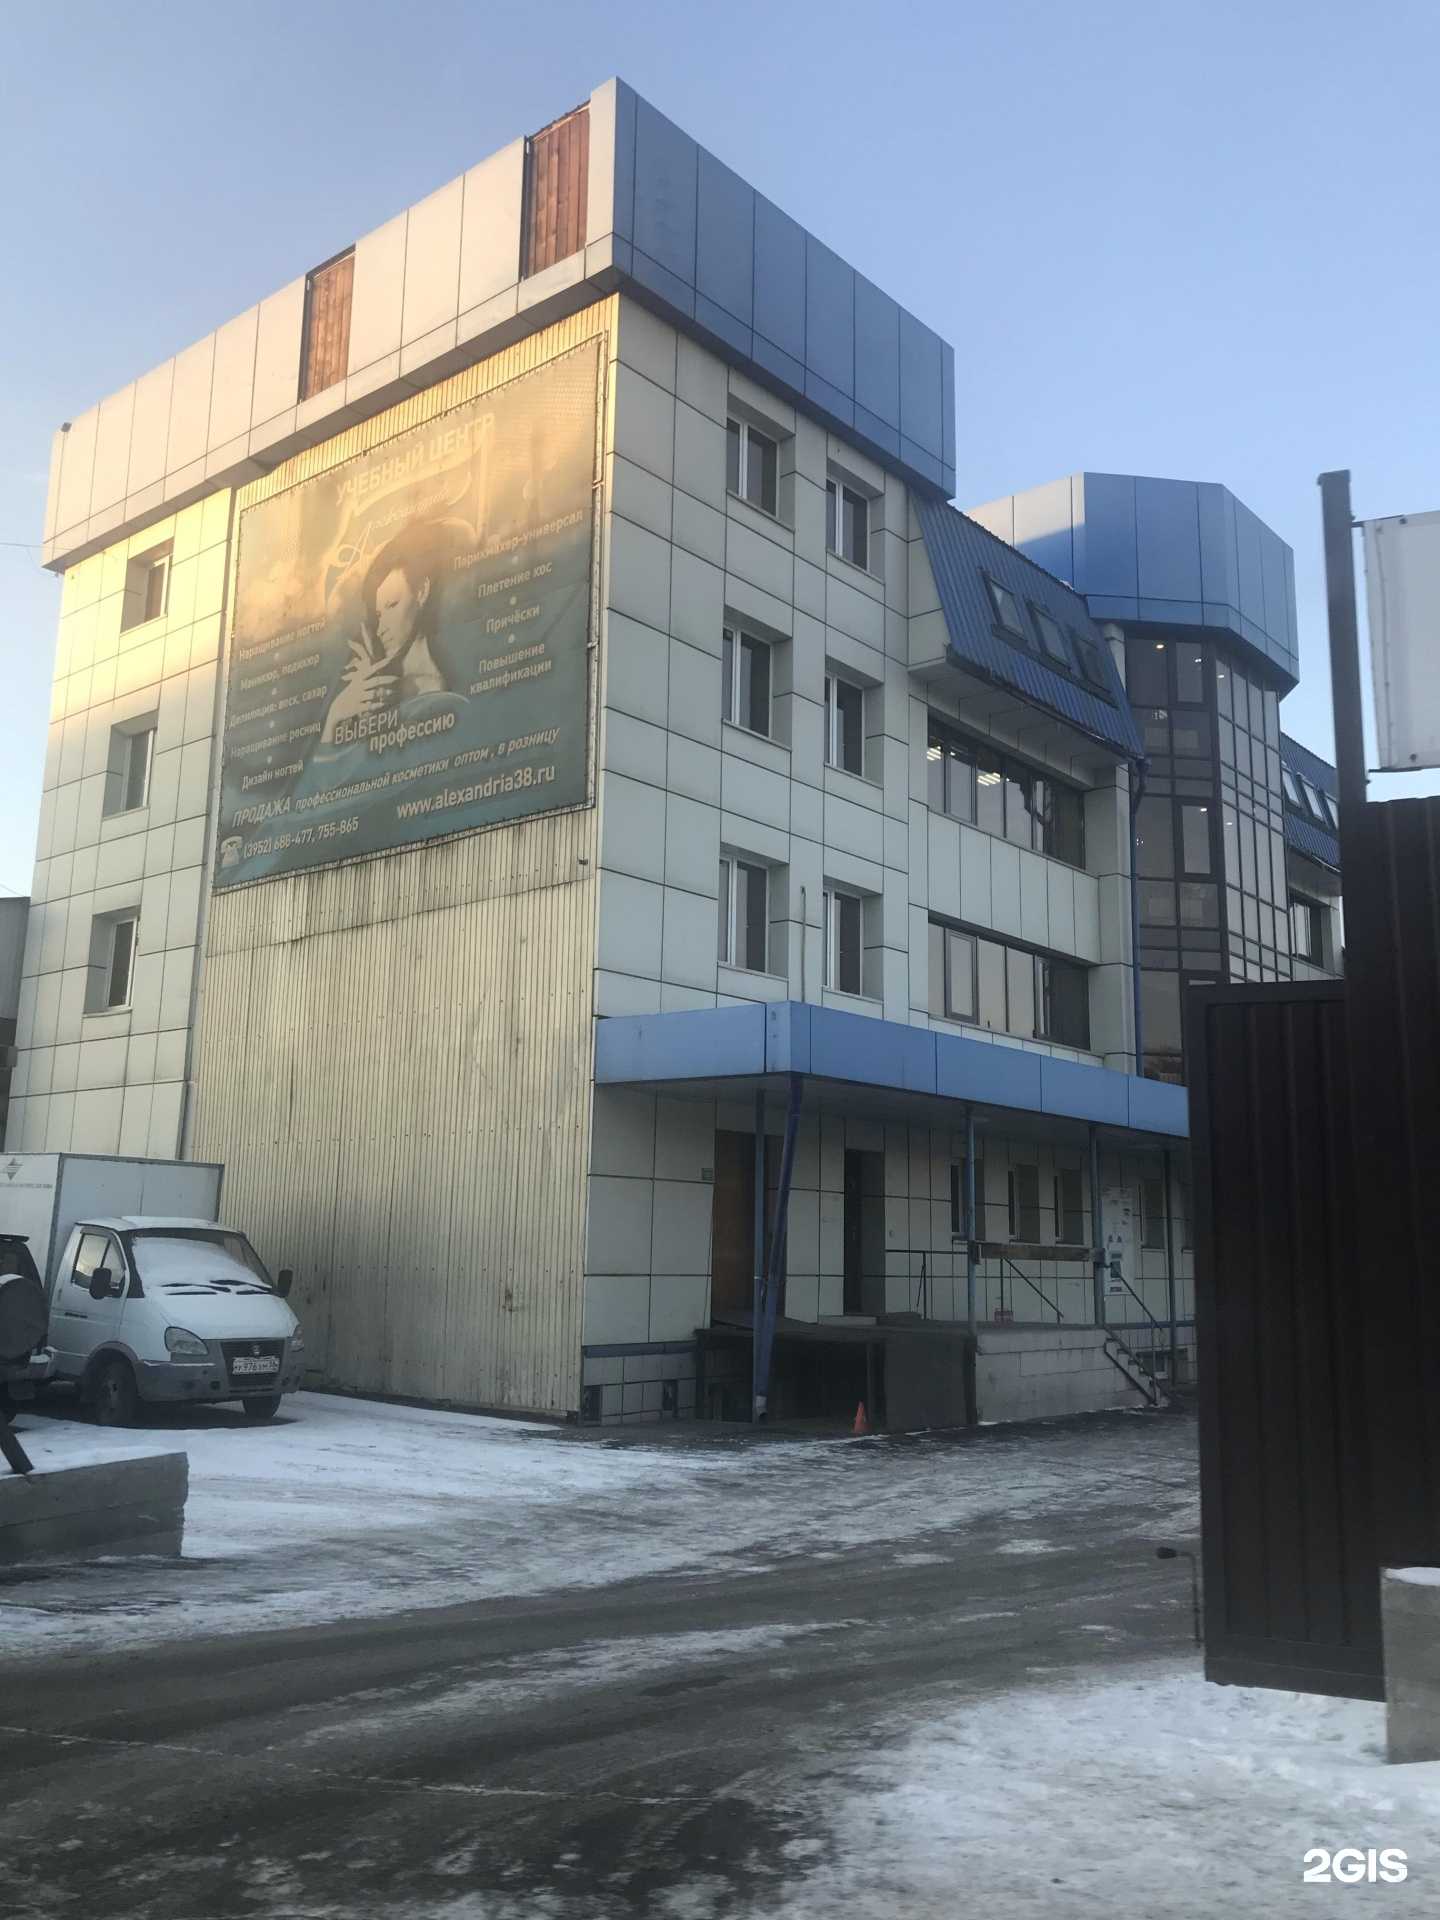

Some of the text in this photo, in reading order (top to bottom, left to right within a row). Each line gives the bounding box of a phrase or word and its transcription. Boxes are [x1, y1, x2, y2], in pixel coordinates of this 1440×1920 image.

[336, 413, 495, 506] УЧЕБНЫЙ ЦЕНТР
[478, 562, 553, 598] Плетение кос
[479, 643, 545, 674] Повышение
[470, 659, 552, 696] квалификации
[335, 709, 399, 745] ВЫБЕРИ
[369, 712, 455, 754] профессию
[232, 796, 292, 828] ПРОДАЖА
[295, 772, 390, 811] профессиональной
[391, 758, 450, 784] косметики
[508, 728, 560, 757] розницу
[241, 760, 304, 792] Дизайн ногтей
[397, 764, 555, 820] www.alexandria38.ru
[318, 816, 359, 838] 755-865
